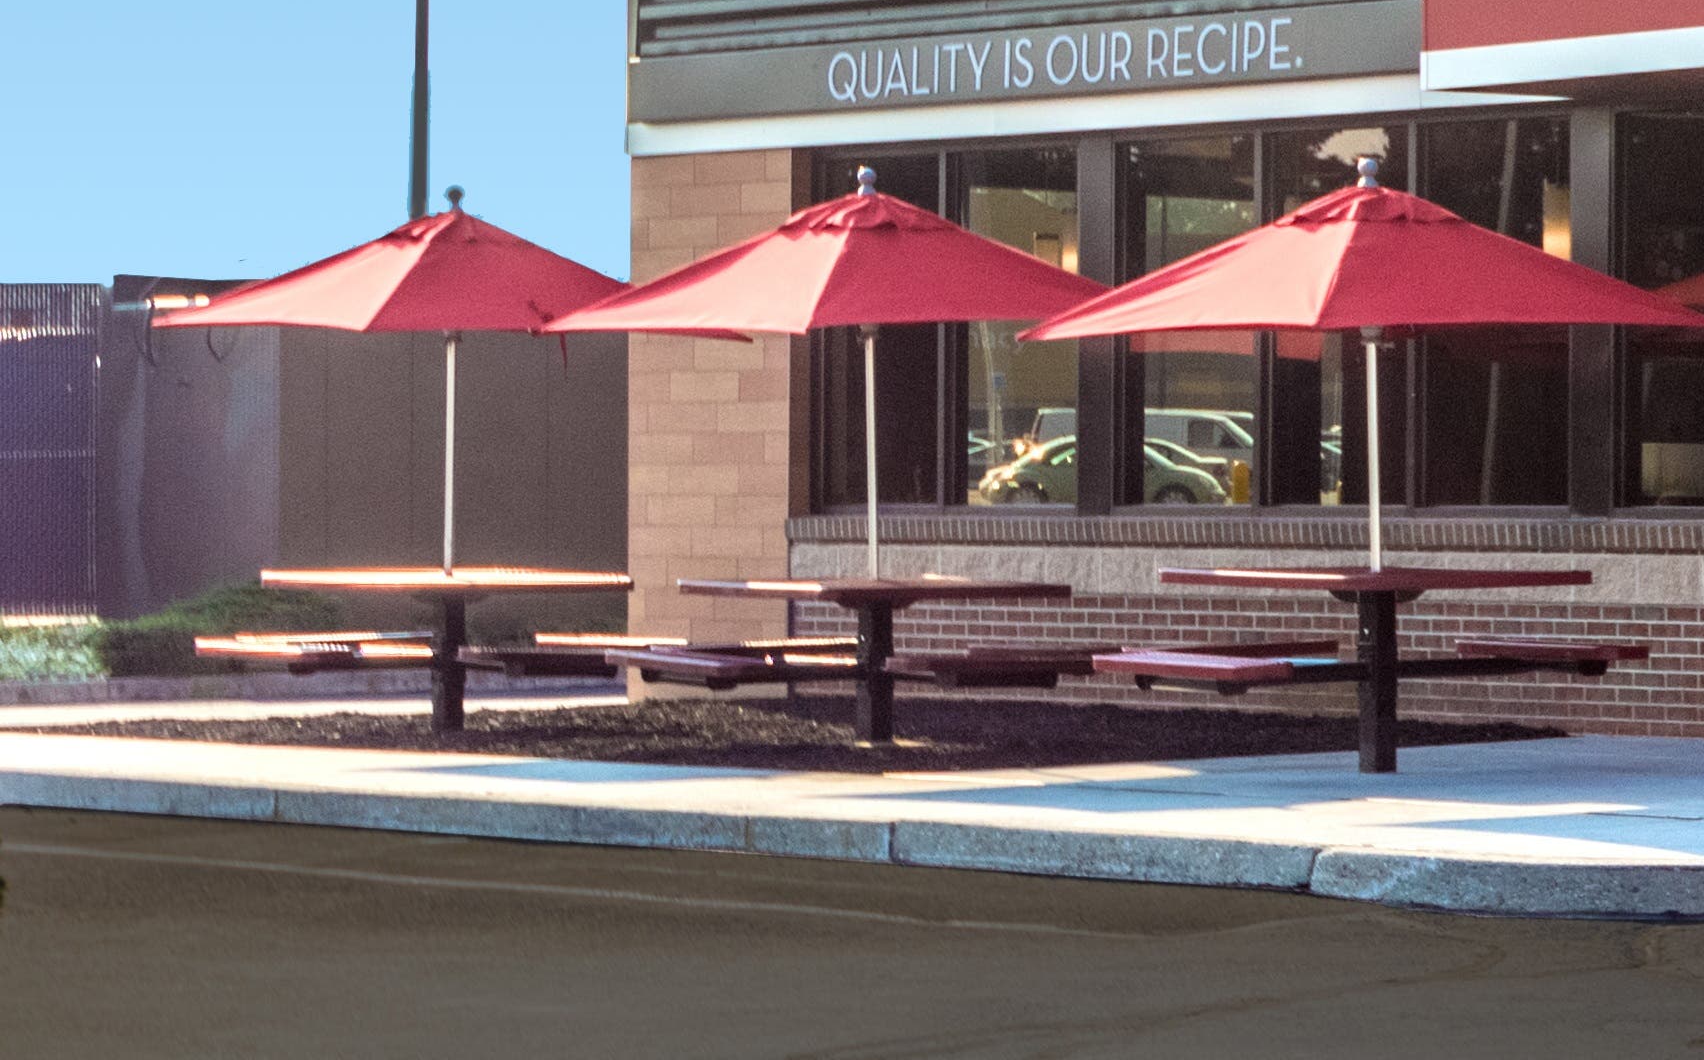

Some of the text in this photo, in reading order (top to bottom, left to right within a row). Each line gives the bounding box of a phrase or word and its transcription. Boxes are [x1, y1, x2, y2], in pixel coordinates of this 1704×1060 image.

[827, 17, 1304, 102] QUALITY IS OUR RECIPE.
